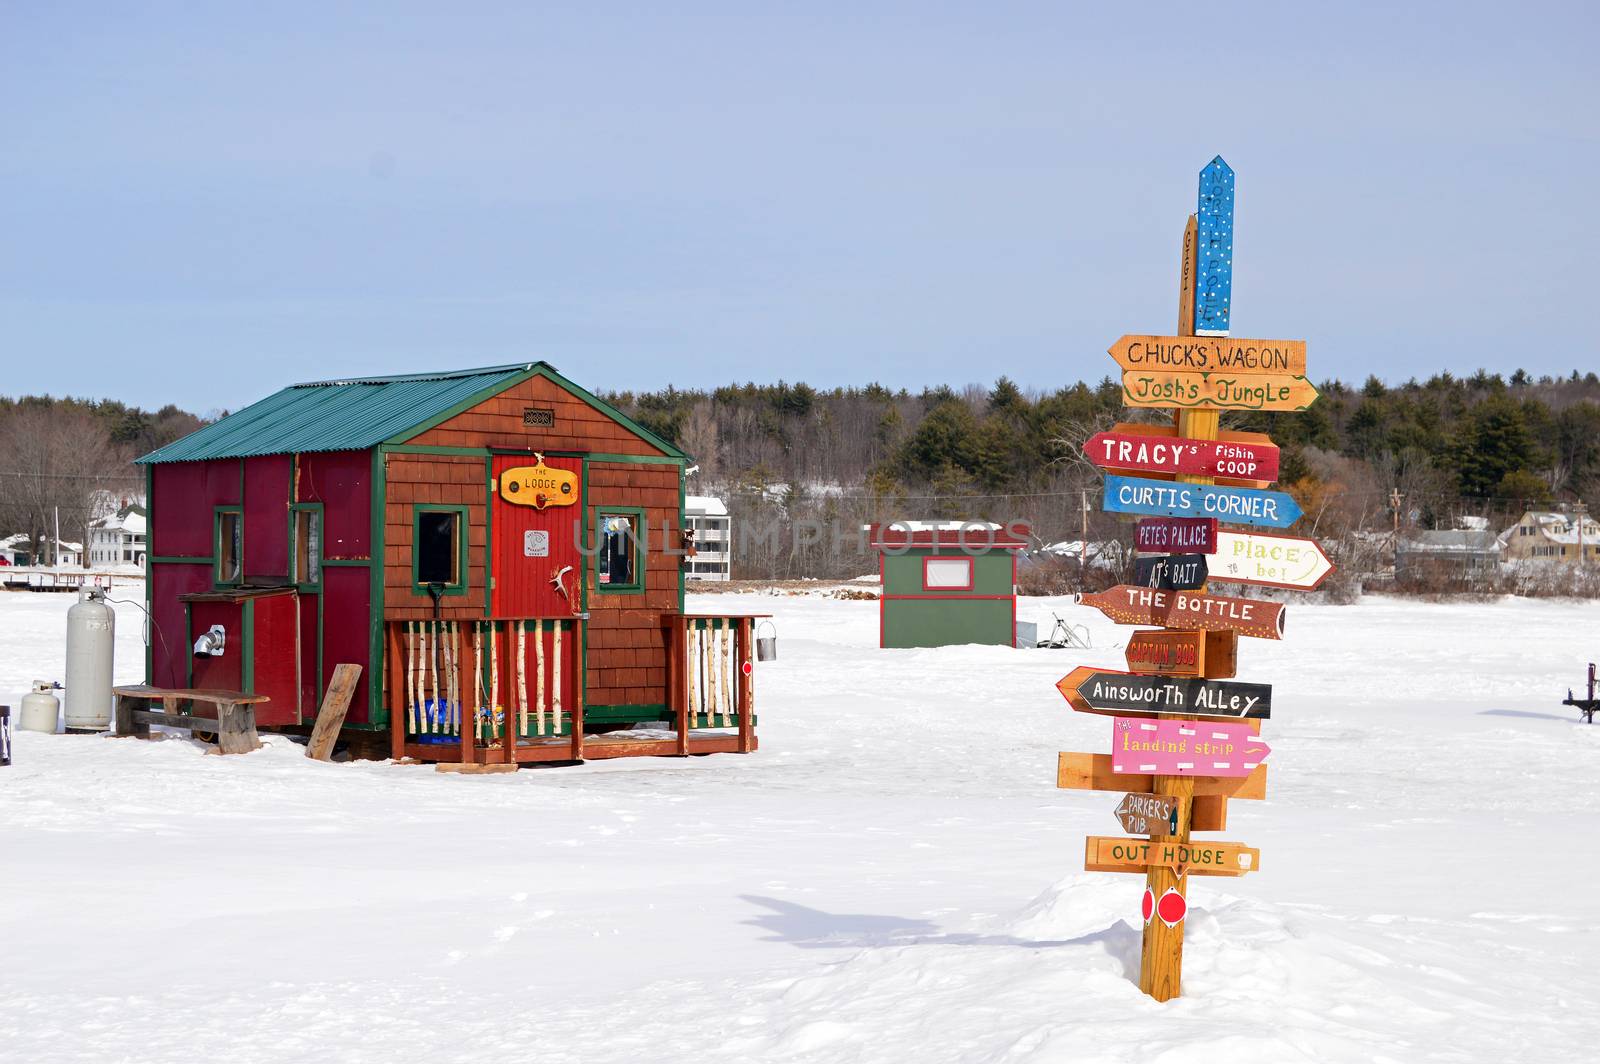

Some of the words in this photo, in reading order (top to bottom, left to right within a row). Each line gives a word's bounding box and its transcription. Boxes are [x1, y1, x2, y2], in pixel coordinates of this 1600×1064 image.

[1209, 170, 1224, 250] NORTH
[1202, 260, 1220, 321] POLE
[1127, 342, 1208, 367] CHUCK'S
[1216, 346, 1289, 370] WAGON
[1136, 377, 1199, 399] Josh's
[1215, 444, 1254, 460] Fishin
[1216, 460, 1257, 476] COOP
[525, 478, 556, 489] LODGE
[1119, 485, 1191, 509] CURTIS
[1204, 493, 1278, 521] CORNER
[1139, 524, 1168, 546] PETE'S
[1171, 525, 1207, 546] PALACE
[1148, 559, 1169, 589] AJ's
[1172, 563, 1198, 584] BAIT
[1126, 589, 1166, 608] THE
[1177, 596, 1254, 620] BOTTLE
[1129, 641, 1169, 665] CAPTAIN
[1176, 643, 1195, 665] BOB
[1122, 732, 1187, 754] landing
[1194, 741, 1233, 756] strip
[1128, 795, 1169, 821] PARKER'S
[1128, 815, 1146, 833] PUB
[1112, 844, 1150, 861] OUT
[1163, 846, 1225, 865] HOUSE
